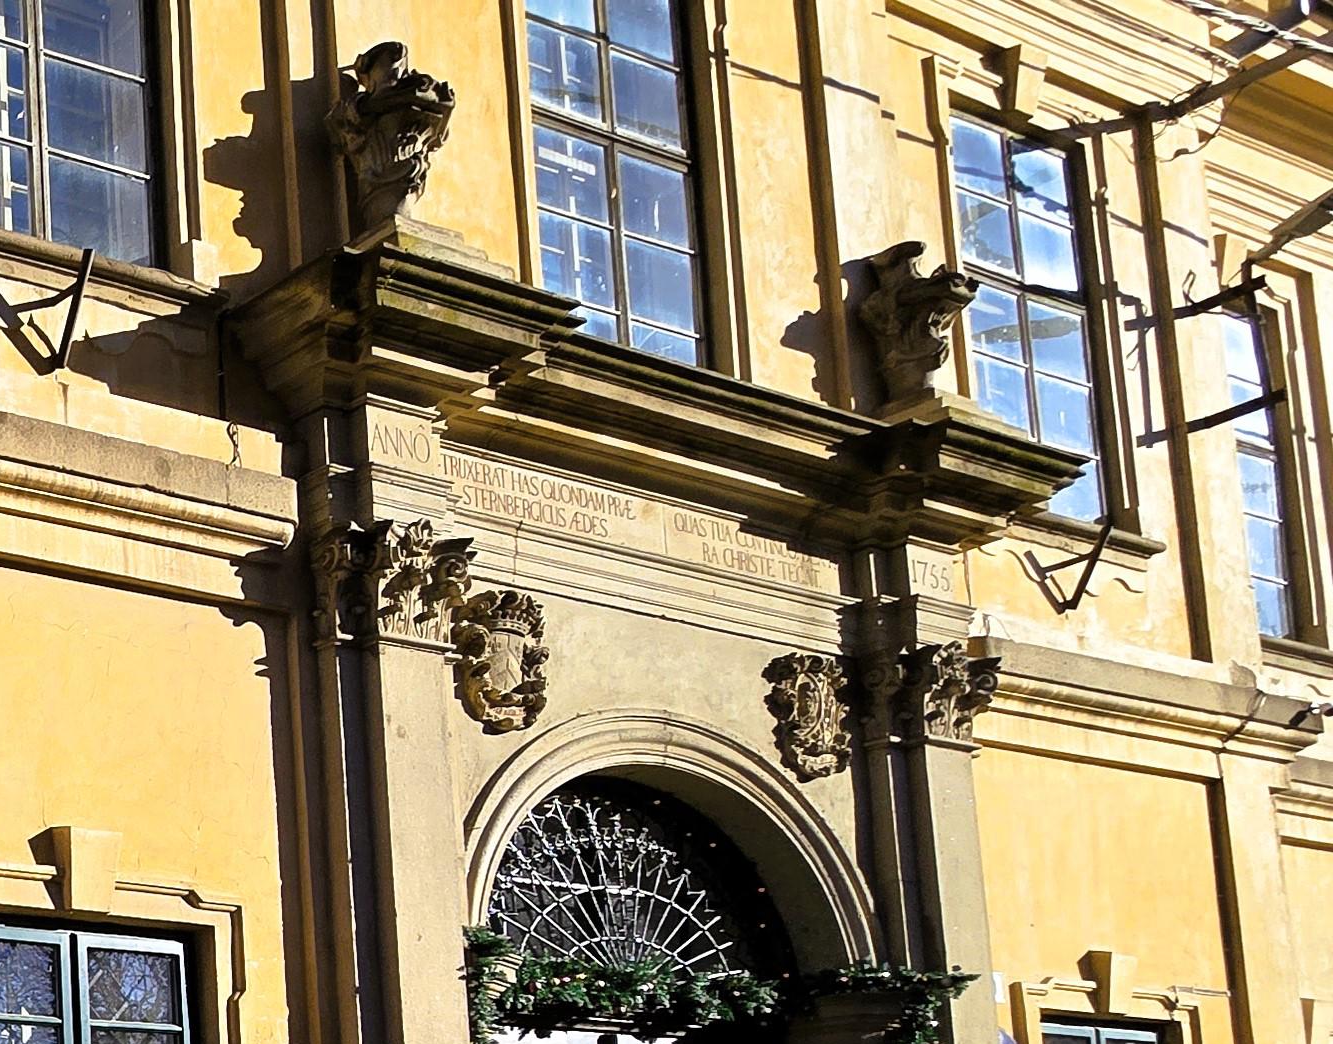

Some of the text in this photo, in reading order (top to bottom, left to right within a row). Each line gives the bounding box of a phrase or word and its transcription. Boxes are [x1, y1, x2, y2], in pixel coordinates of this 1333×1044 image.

[511, 470, 540, 497] HAS
[541, 478, 606, 514] QUONDAM
[673, 511, 708, 538] QUAS
[707, 518, 733, 544] TUA
[701, 541, 721, 565] RA
